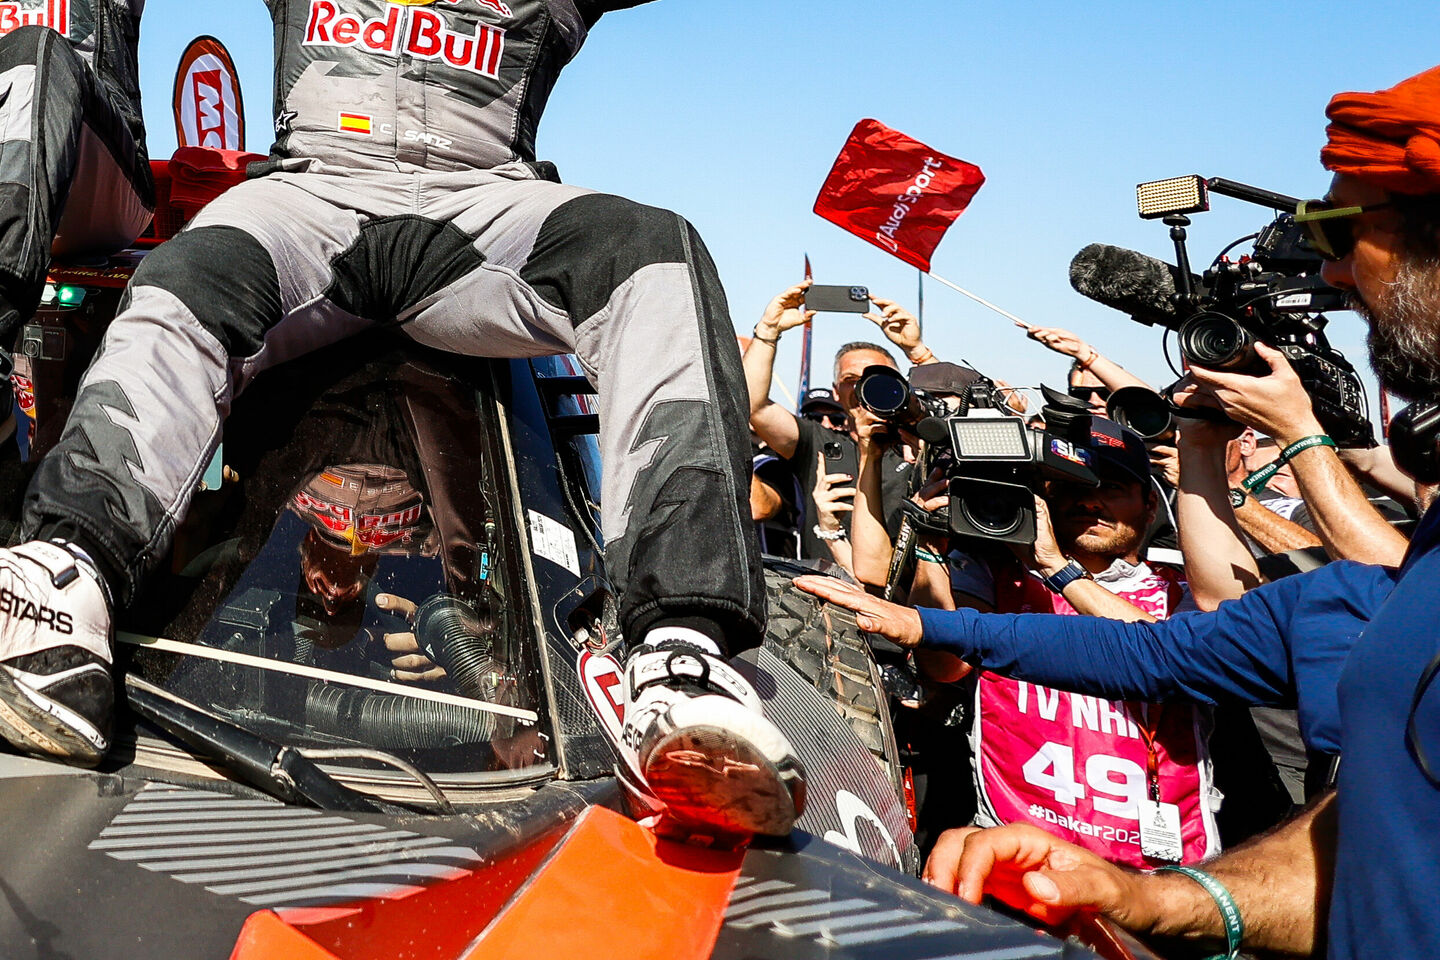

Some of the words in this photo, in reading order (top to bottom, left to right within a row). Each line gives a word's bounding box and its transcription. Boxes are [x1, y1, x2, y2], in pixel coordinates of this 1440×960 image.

[406, 8, 504, 77] Bull
[878, 201, 910, 239] Audi
[897, 156, 942, 204] Sport
[1022, 740, 1148, 821] 49
[1028, 803, 1141, 846] #Dakar202
